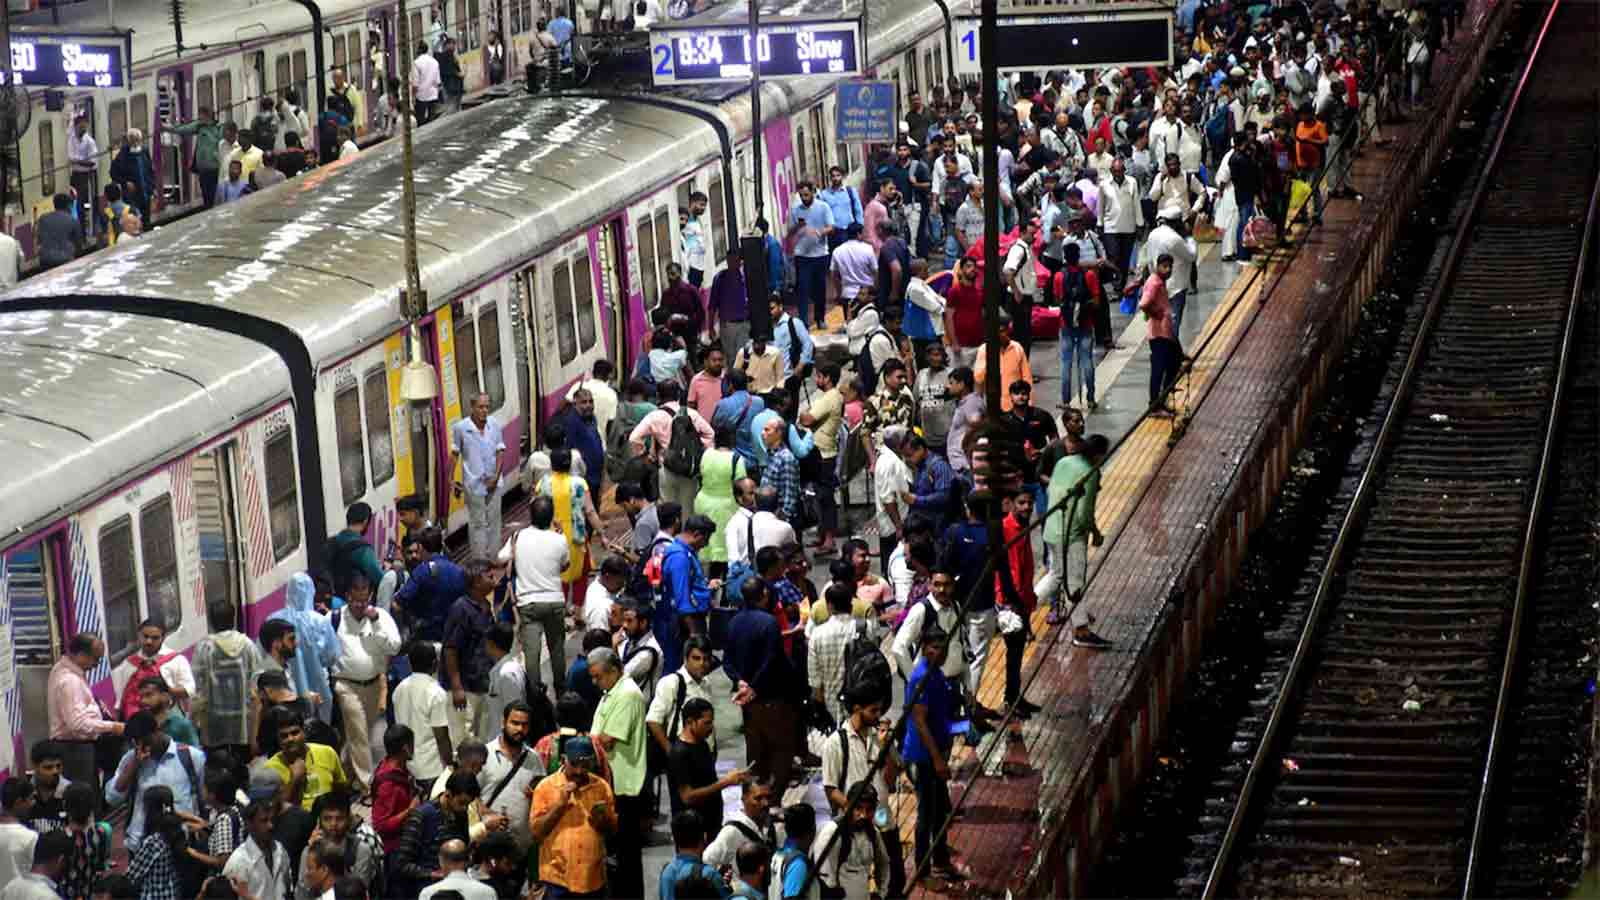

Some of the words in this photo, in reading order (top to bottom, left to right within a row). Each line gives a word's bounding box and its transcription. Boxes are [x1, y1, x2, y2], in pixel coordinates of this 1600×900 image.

[61, 42, 110, 72] Slow
[655, 44, 673, 75] 2
[679, 36, 722, 66] 9:34
[796, 32, 843, 60] Slow
[961, 30, 975, 61] 1
